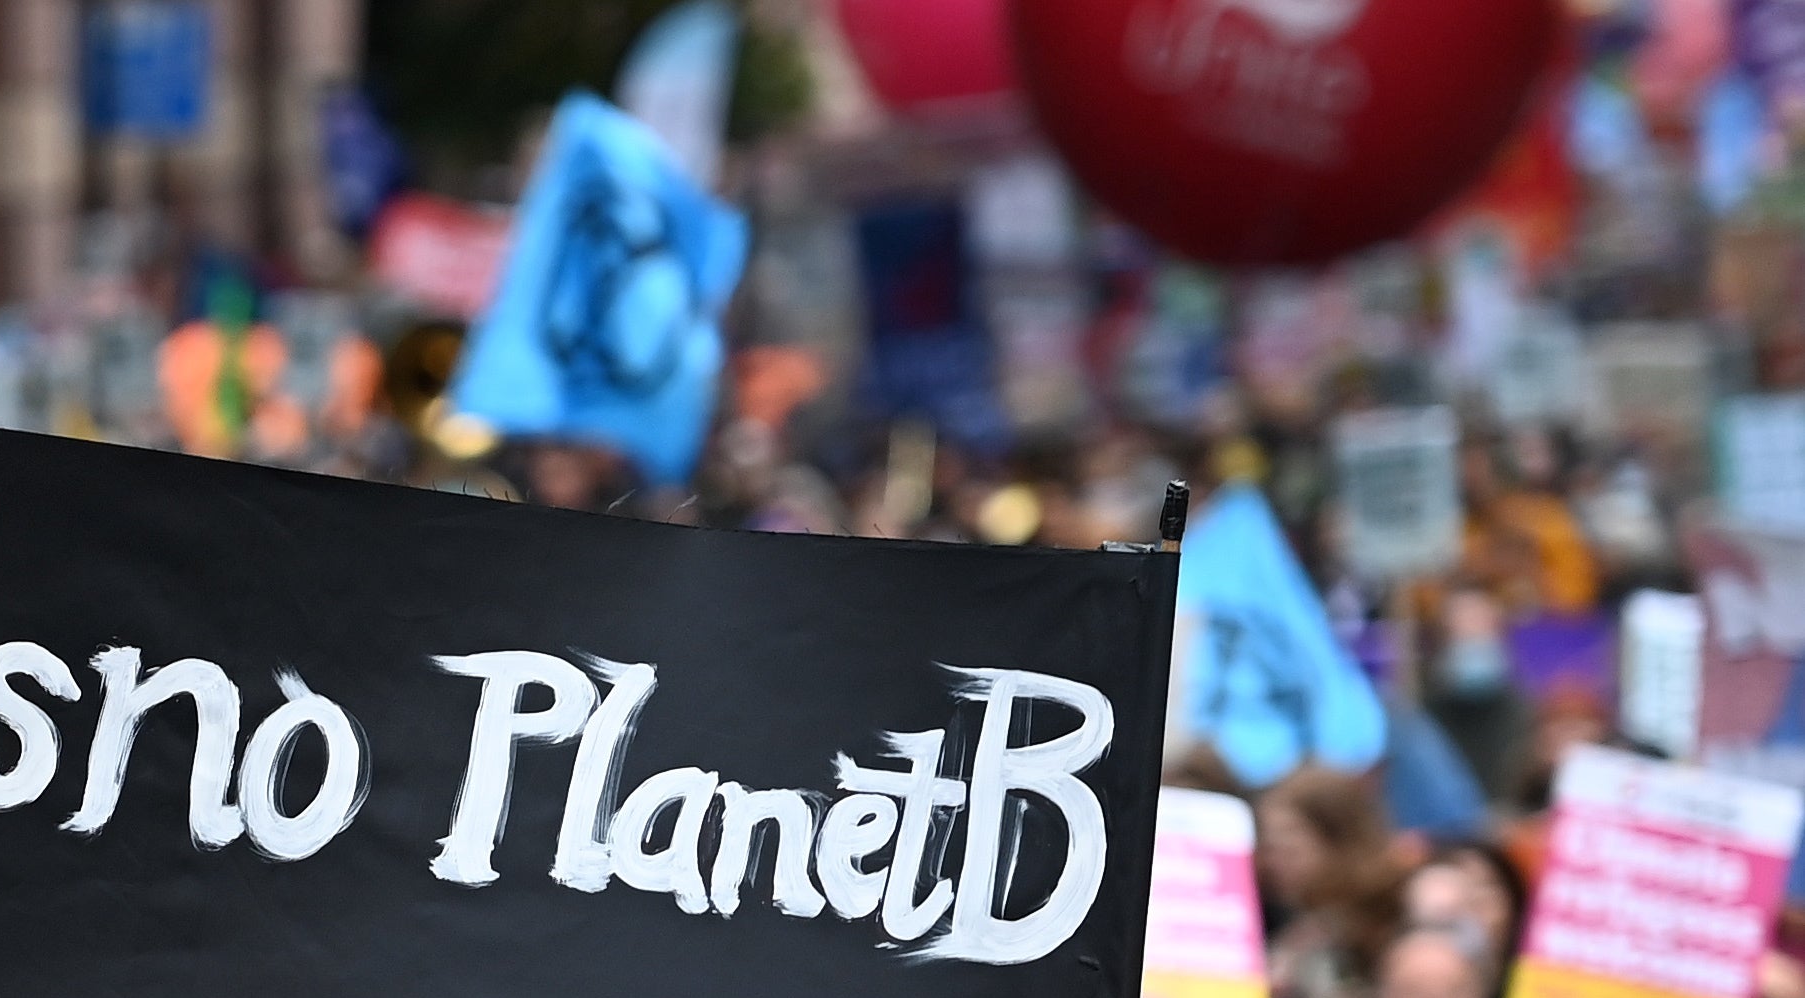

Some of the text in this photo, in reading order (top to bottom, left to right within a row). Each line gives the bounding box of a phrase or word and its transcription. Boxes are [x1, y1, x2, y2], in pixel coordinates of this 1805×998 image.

[59, 642, 373, 863] no
[429, 646, 968, 944] Planet
[900, 661, 1115, 965] B
